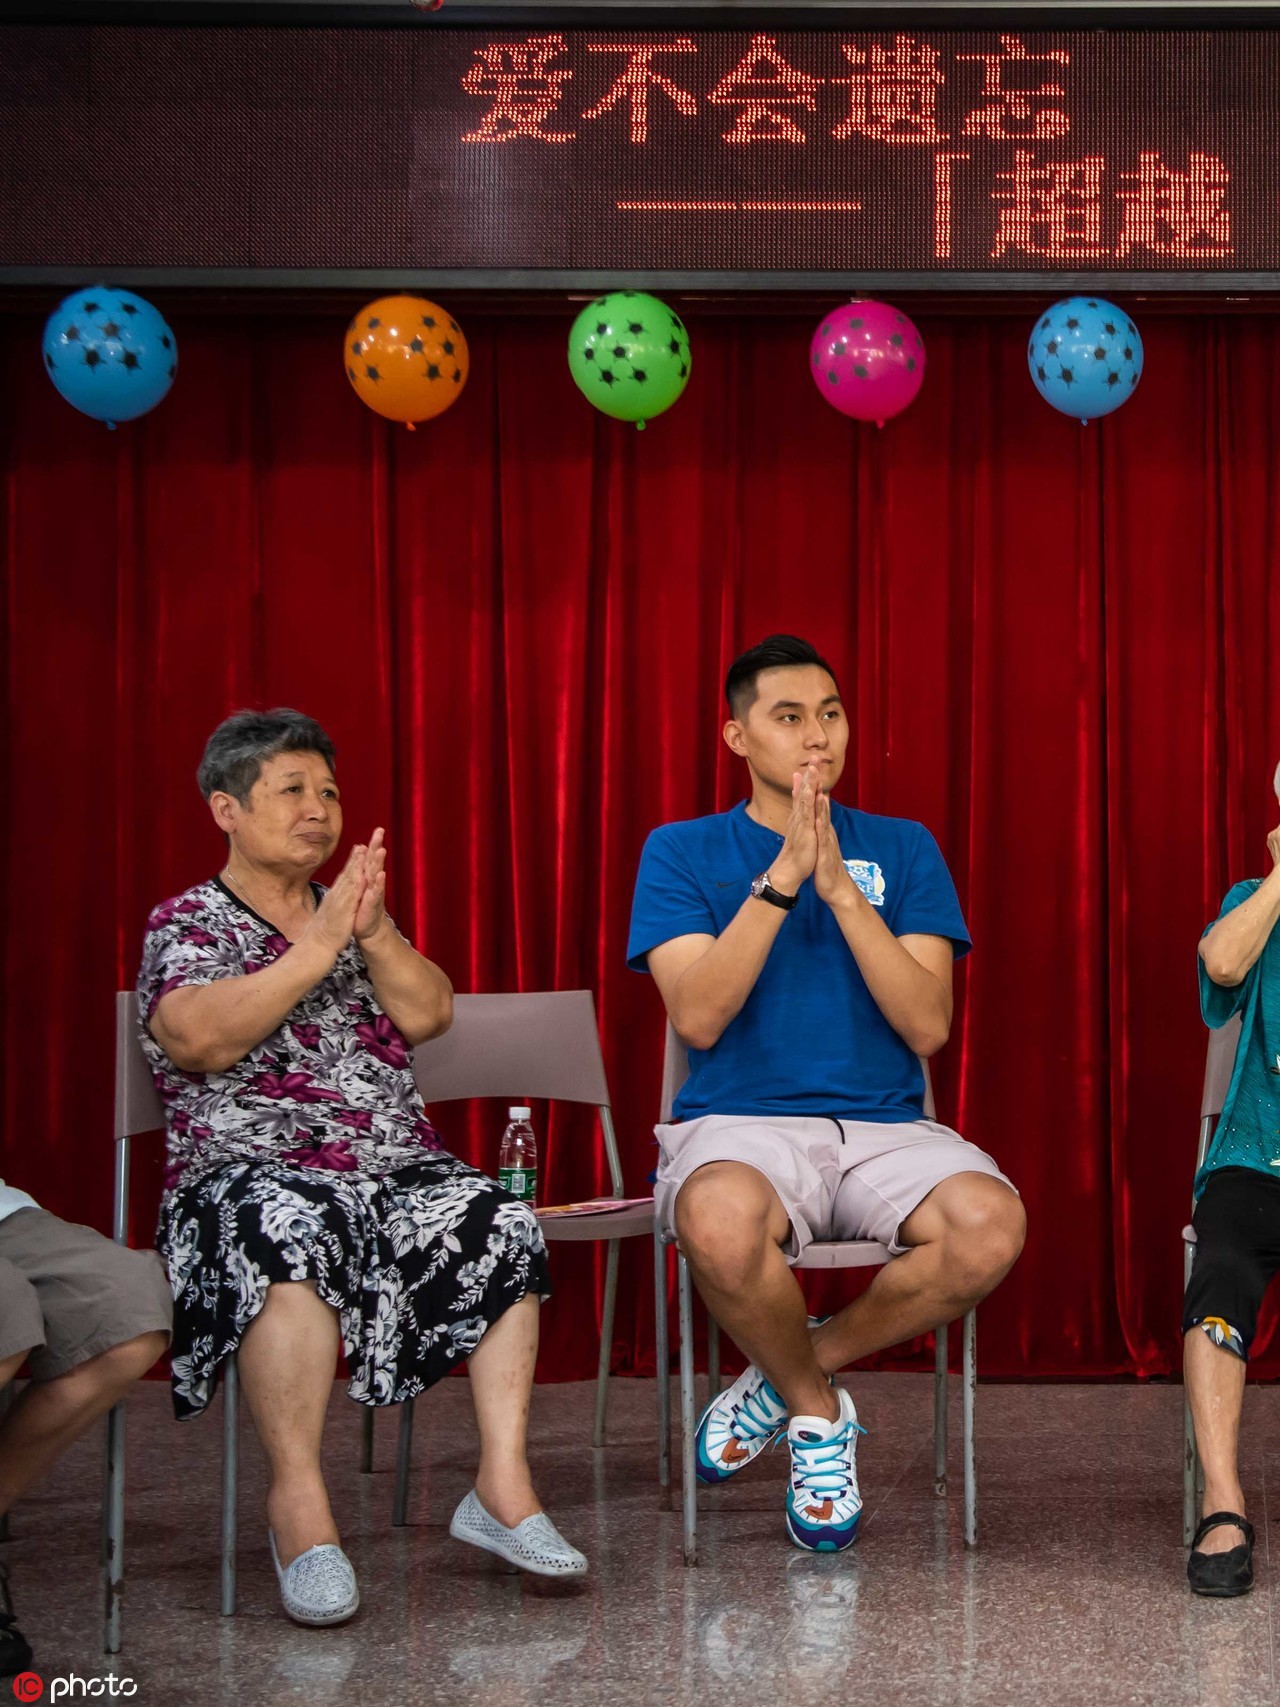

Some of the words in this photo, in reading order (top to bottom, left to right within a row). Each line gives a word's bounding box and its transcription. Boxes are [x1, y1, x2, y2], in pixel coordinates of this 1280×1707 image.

[461, 35, 1069, 144] 爱不会遗忘
